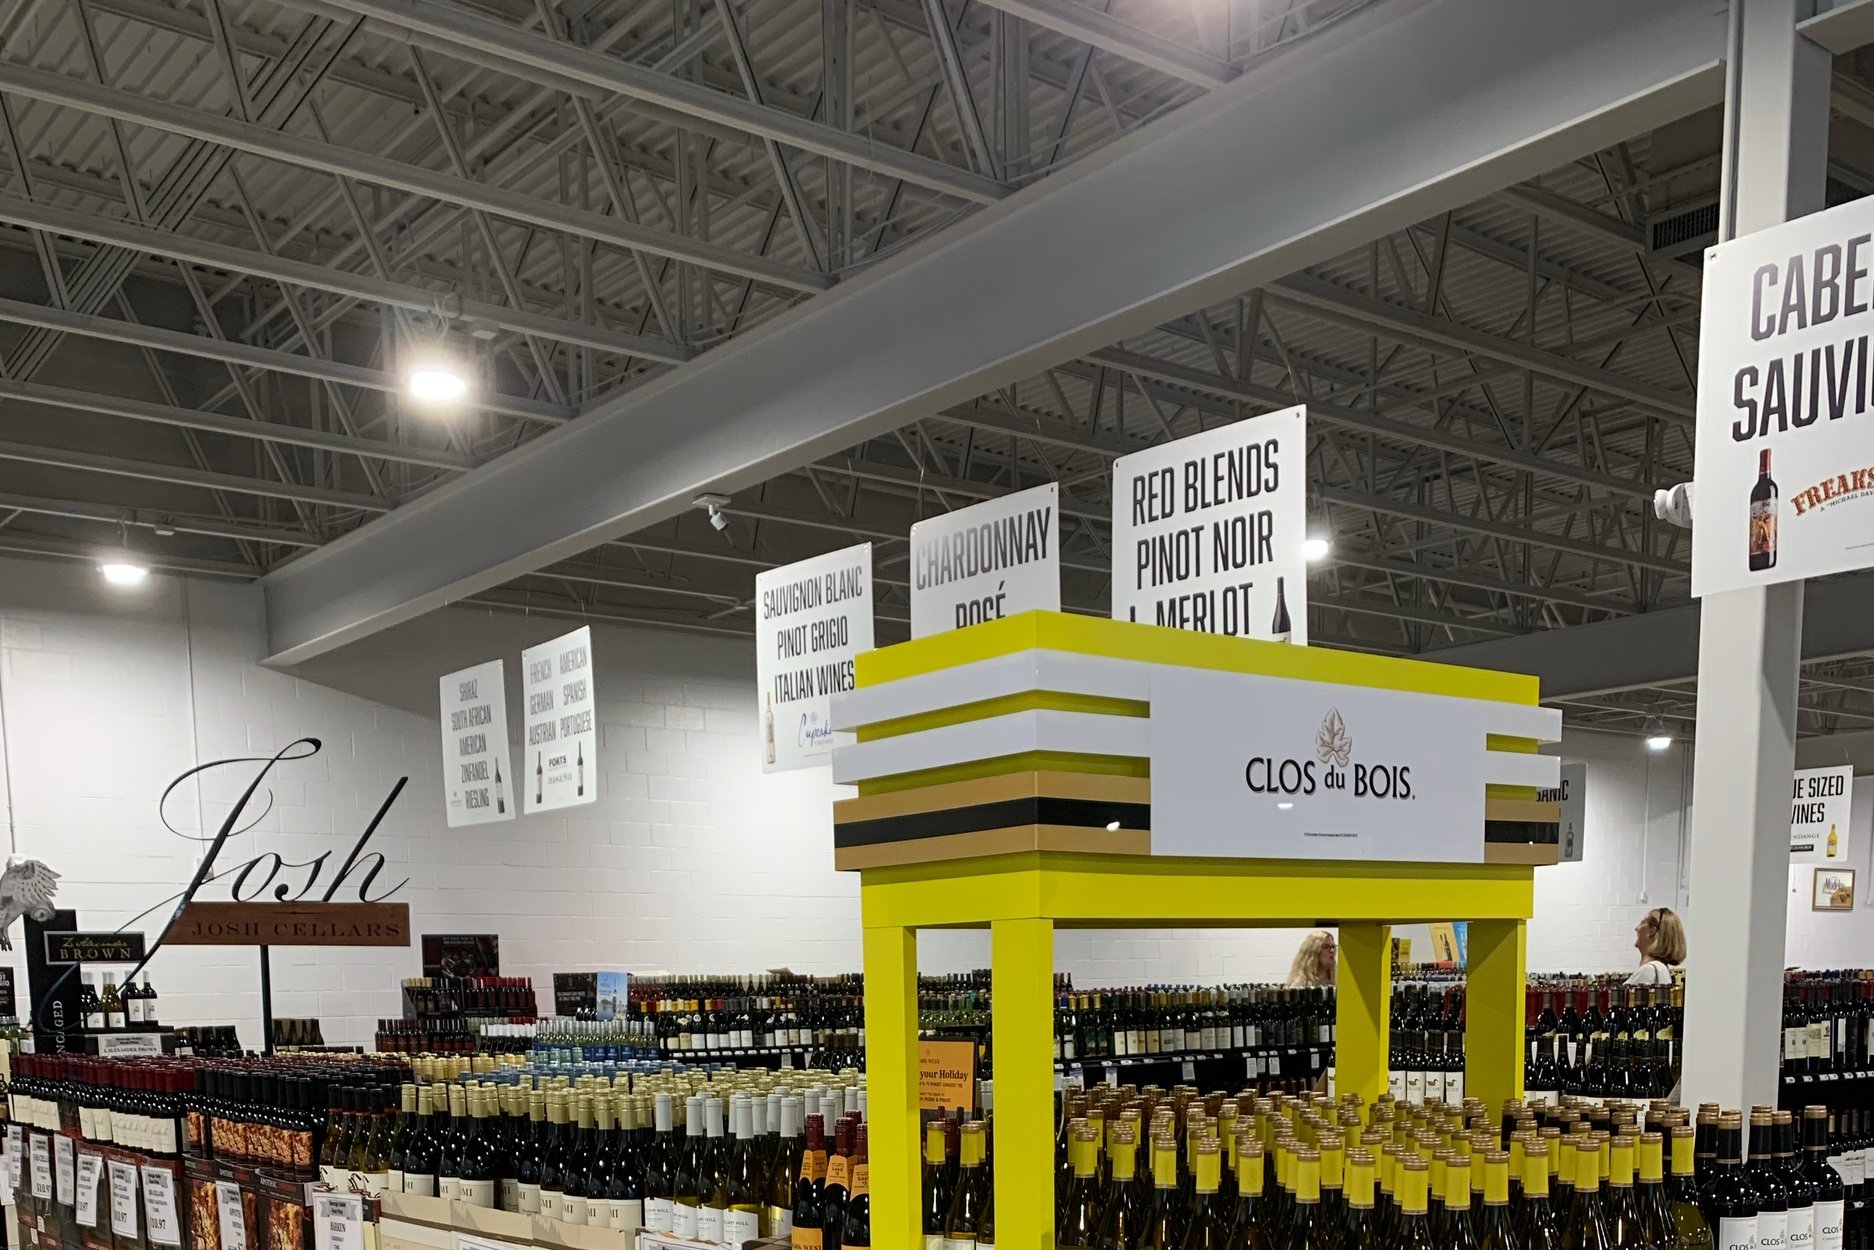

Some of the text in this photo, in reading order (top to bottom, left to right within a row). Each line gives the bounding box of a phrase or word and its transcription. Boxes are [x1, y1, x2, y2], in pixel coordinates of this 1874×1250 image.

[1751, 233, 1874, 342] CABE
[1733, 336, 1874, 442] SAUVI
[1132, 439, 1278, 527] RED BLENDS
[916, 507, 1051, 590] CHARDONNAY
[1138, 509, 1273, 590] PINOT NOIR
[764, 566, 862, 620] SAUVIGNON BLANC
[1156, 582, 1253, 637] MERLOT
[778, 616, 848, 660] PINOT GRIGIO
[530, 646, 587, 684] FRENCH AMERICAN
[775, 660, 854, 704] ITALIAN WINES
[460, 679, 478, 701] SHIRAZ
[530, 679, 586, 715] GERMAN SPANISH
[451, 704, 491, 731] SOUTH AFRICAN
[529, 710, 592, 746] AUSTRIAN PORTUGUESE
[798, 712, 831, 748] Cupcak
[459, 733, 486, 756] AMERICAN
[549, 755, 567, 766] PORTS
[461, 761, 489, 783] ZINFANDEL
[1246, 757, 1316, 795] CLOS
[1325, 765, 1345, 789] du
[1809, 775, 1843, 798] SIZED
[465, 788, 489, 809] RIESLING
[192, 922, 402, 937] JOSH CELLARS
[60, 948, 131, 959] BROWN
[920, 1070, 968, 1081] your Holiday
[1822, 1225, 1840, 1235] CLOS
